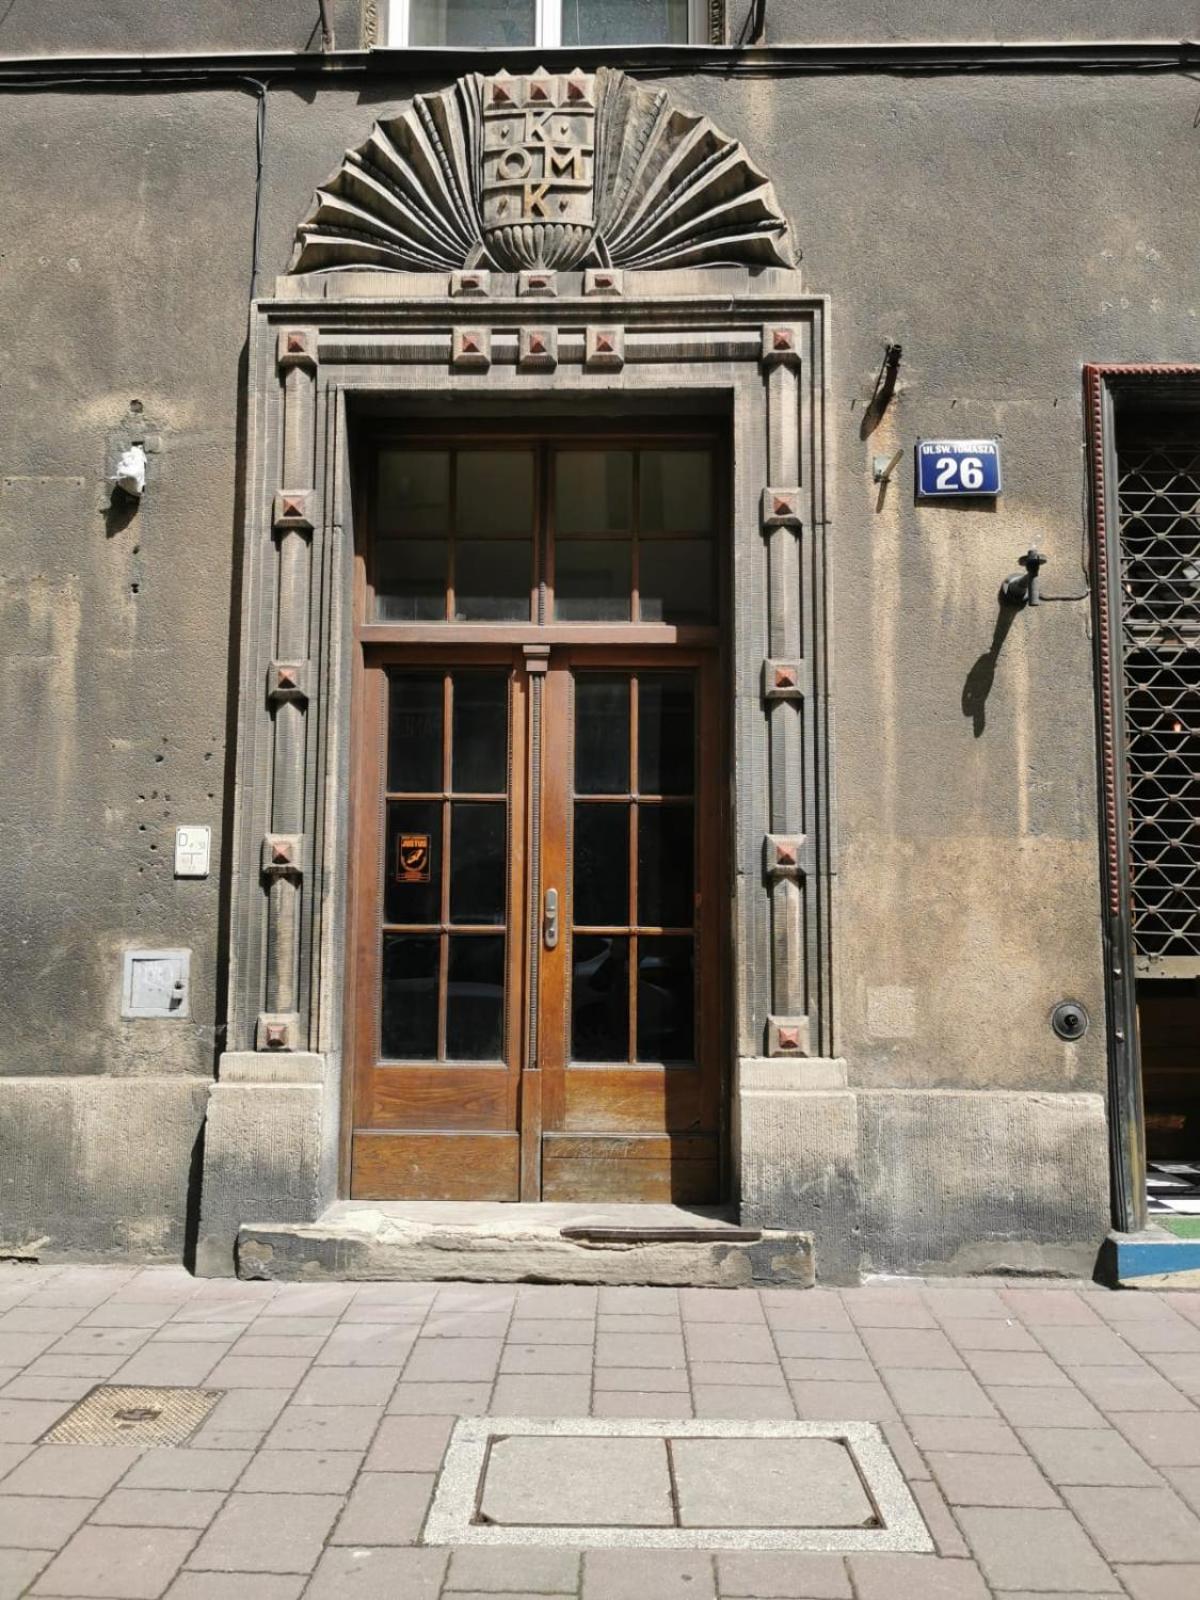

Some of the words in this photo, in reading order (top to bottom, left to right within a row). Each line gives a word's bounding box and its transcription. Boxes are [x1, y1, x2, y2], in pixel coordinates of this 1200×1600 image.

[525, 111, 554, 143] K
[523, 183, 551, 219] K
[936, 457, 984, 490] 26
